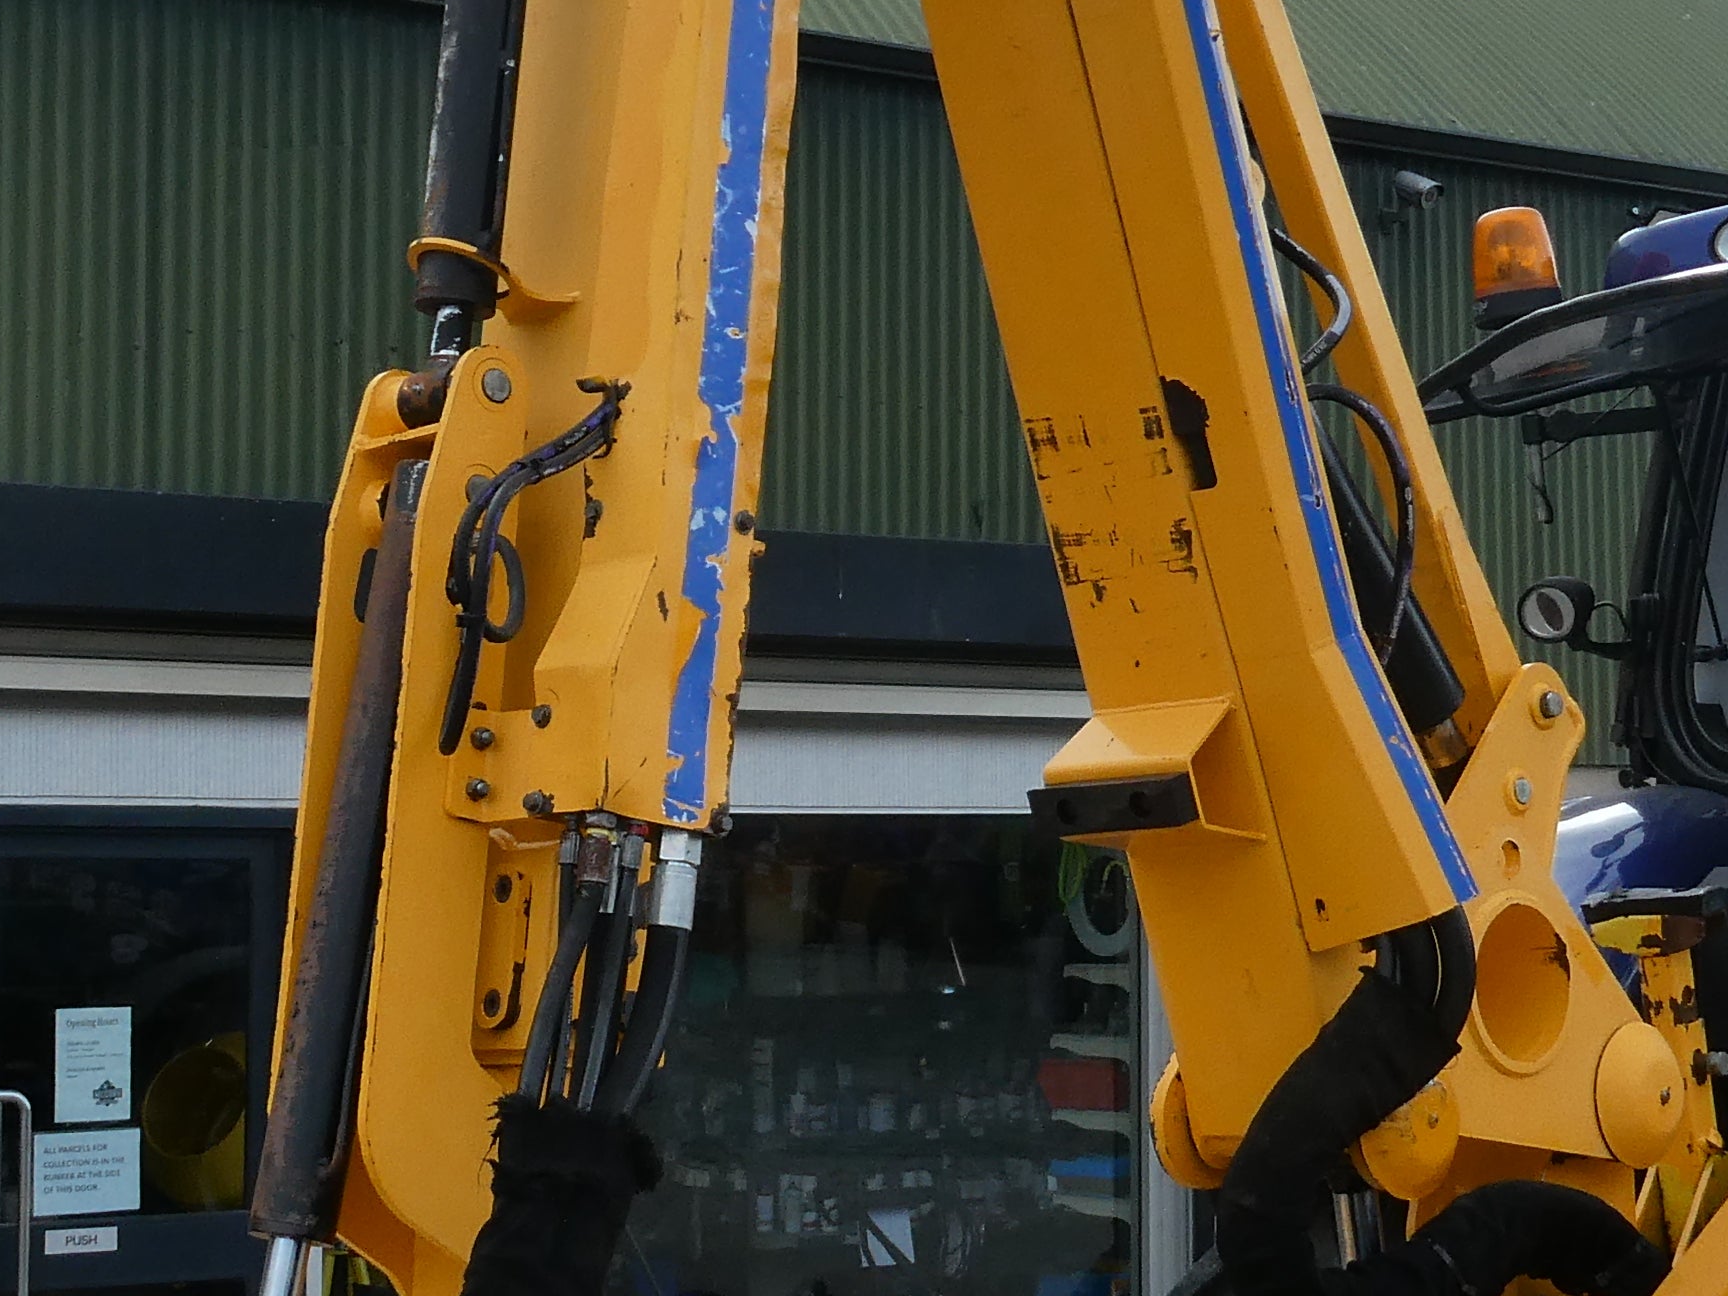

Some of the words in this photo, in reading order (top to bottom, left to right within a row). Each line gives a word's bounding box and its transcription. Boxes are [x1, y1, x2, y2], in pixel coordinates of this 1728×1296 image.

[43, 1159, 90, 1169] COLLECTION
[111, 1156, 125, 1164] THE
[88, 1170, 103, 1178] THE
[43, 1186, 54, 1194] OF
[56, 1185, 73, 1193] THIS
[65, 1234, 98, 1246] PUSH
